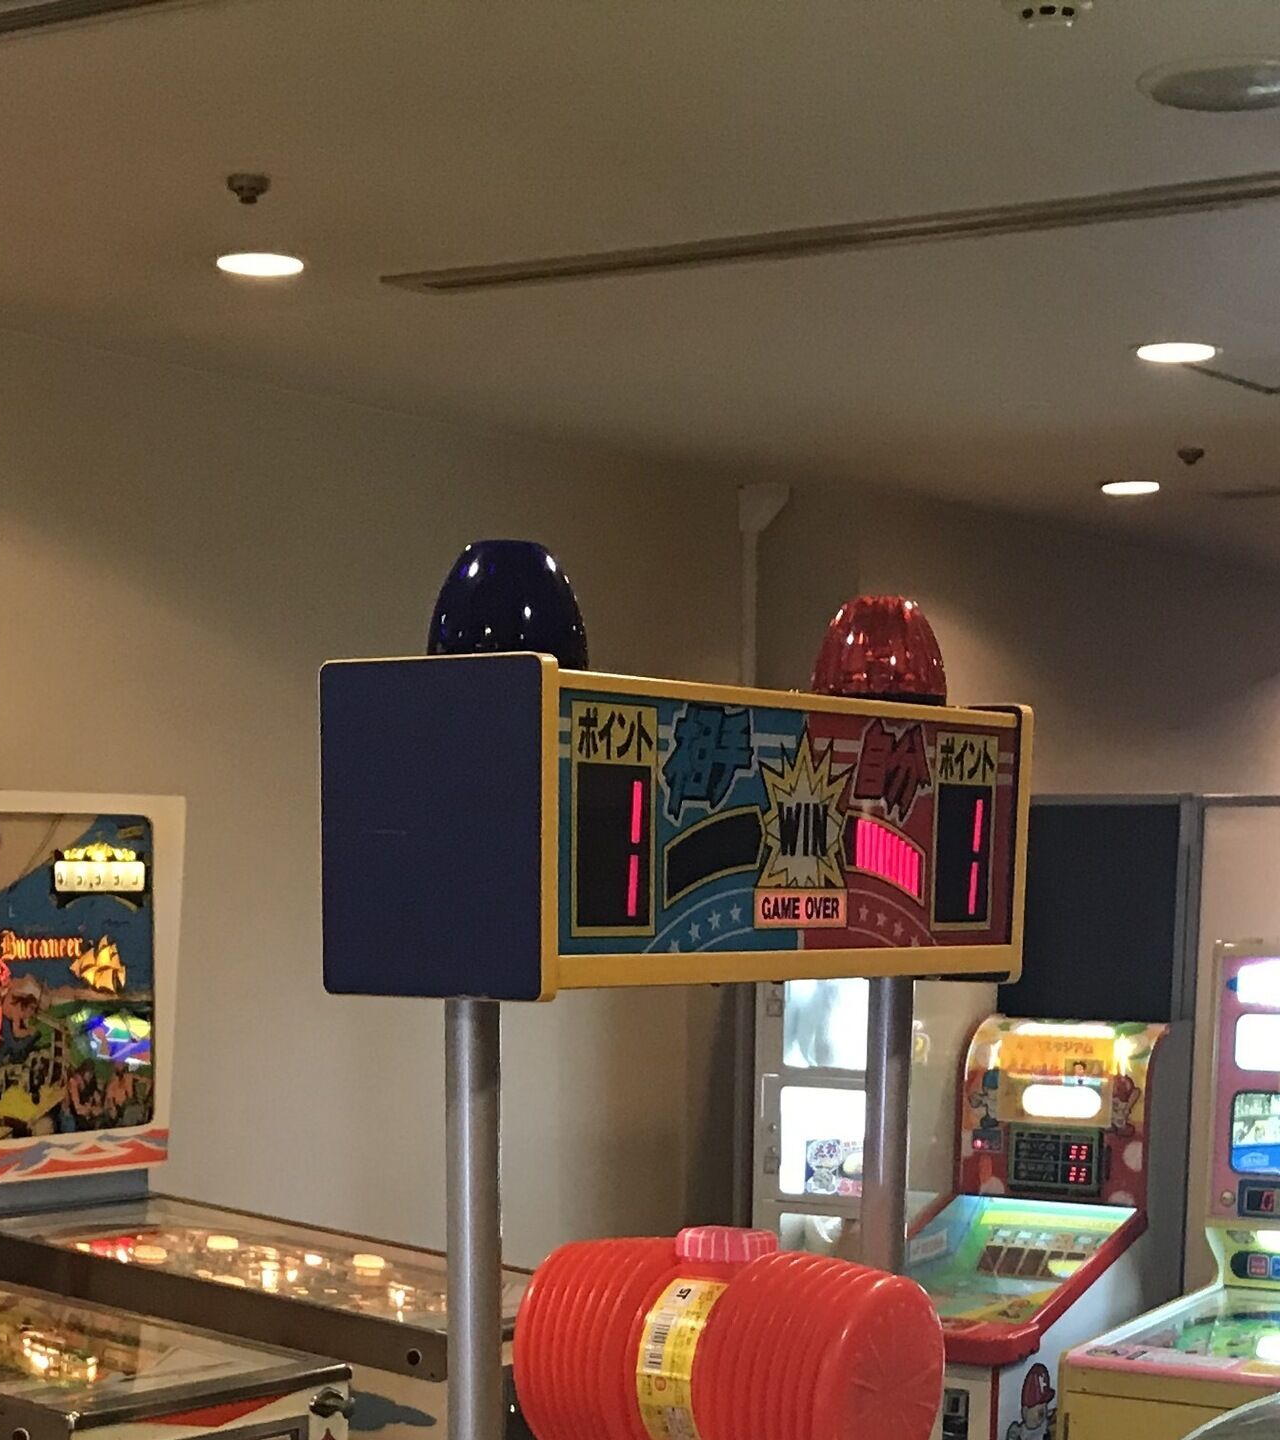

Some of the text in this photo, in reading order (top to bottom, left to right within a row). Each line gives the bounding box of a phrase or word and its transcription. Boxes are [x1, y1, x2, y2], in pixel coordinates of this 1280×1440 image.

[578, 706, 654, 762] ポイント
[938, 735, 995, 783] ポイント
[777, 801, 829, 857] WIN
[761, 896, 840, 921] GAME OVER
[0, 929, 84, 961] Buccaneer
